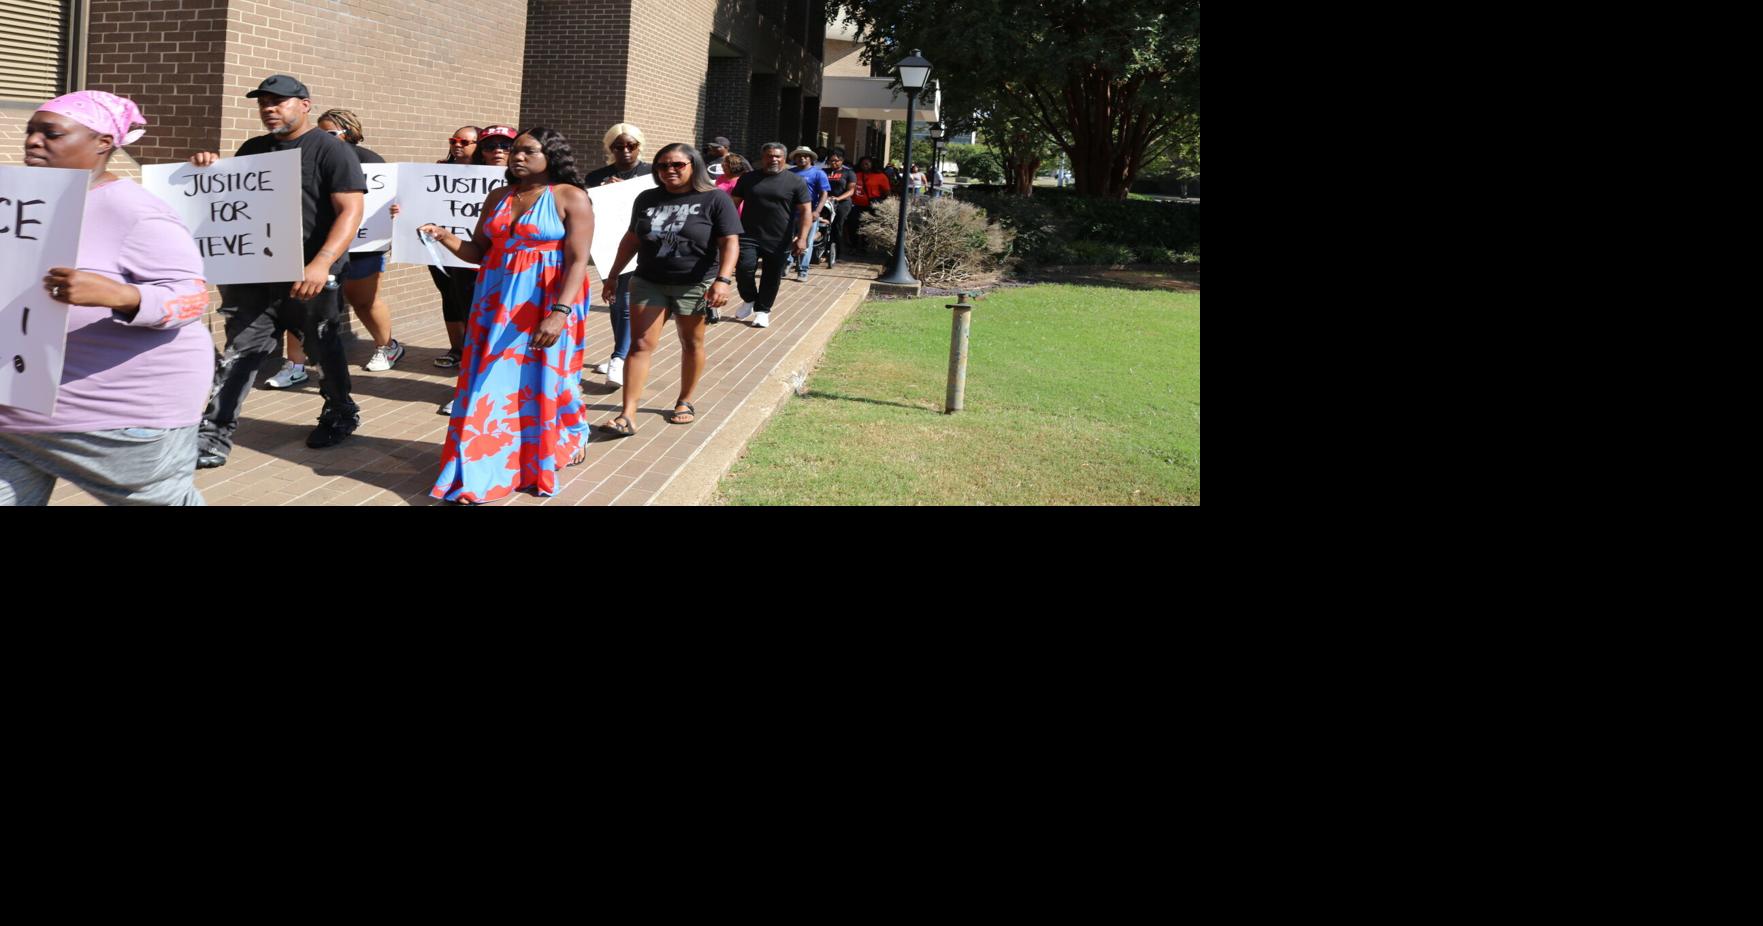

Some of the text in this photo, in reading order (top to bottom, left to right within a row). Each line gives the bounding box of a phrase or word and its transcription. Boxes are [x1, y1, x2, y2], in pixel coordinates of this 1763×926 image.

[182, 170, 275, 197] JUSTICE
[210, 200, 252, 222] FOR
[194, 232, 256, 258] TEVE
